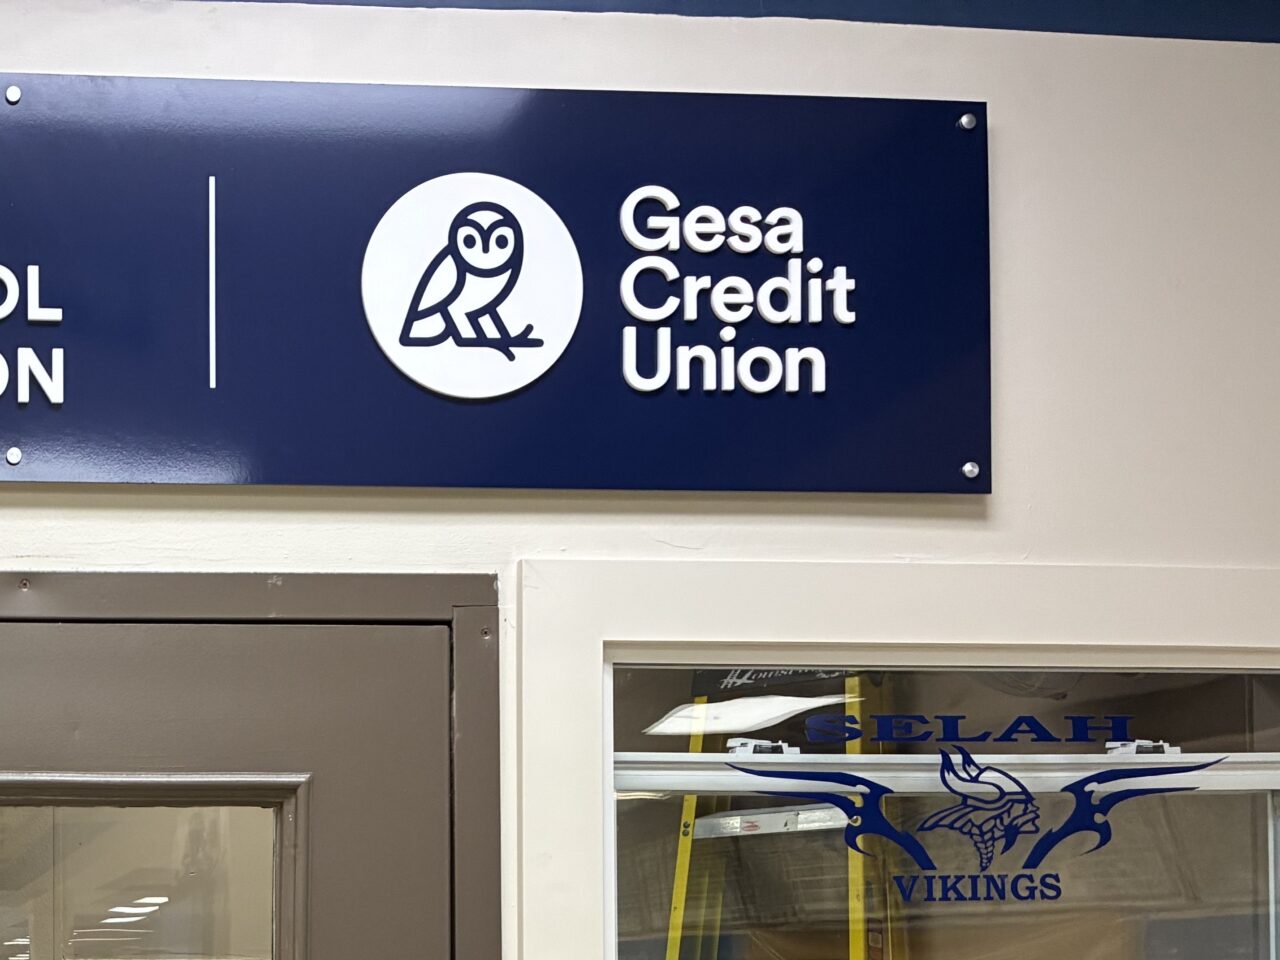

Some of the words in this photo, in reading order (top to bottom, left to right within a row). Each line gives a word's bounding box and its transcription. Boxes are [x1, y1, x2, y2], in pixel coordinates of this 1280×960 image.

[620, 185, 804, 254] Gesa
[620, 256, 856, 324] Credit
[623, 326, 827, 393] Union
[805, 714, 1135, 743] SELAH
[893, 873, 1062, 903] VIKINGS
